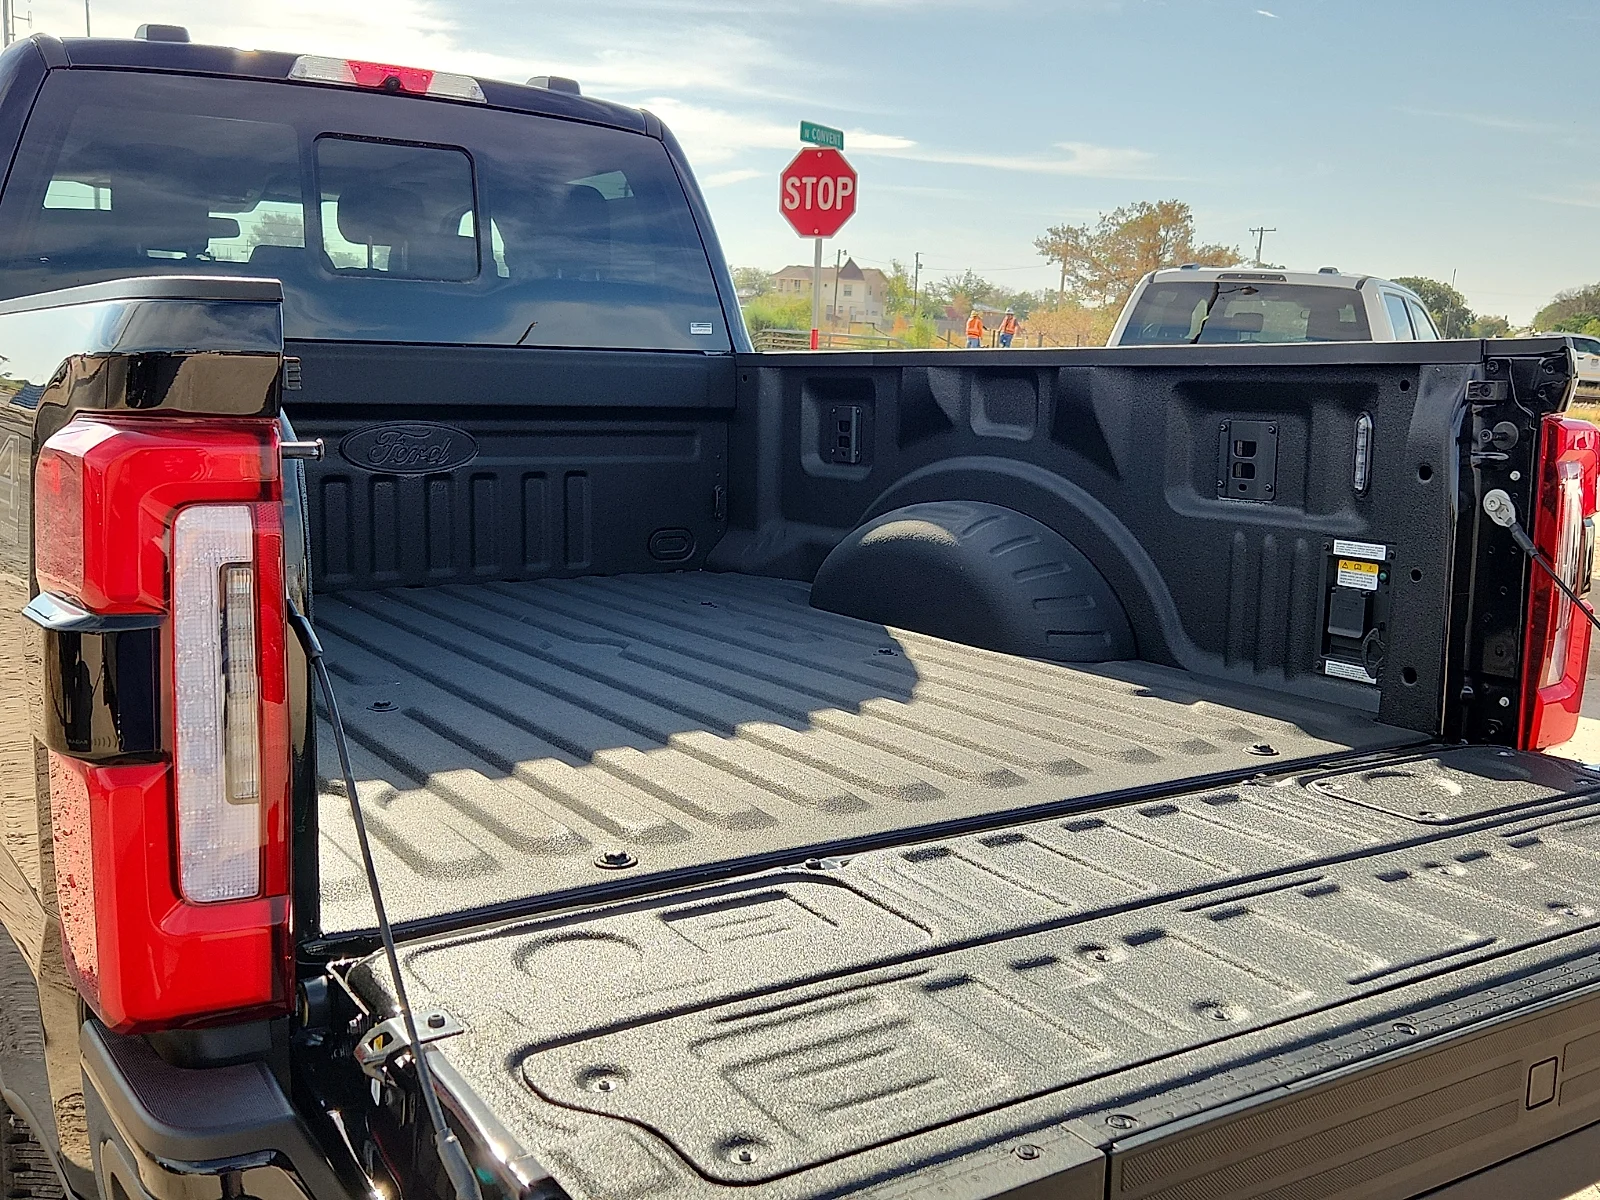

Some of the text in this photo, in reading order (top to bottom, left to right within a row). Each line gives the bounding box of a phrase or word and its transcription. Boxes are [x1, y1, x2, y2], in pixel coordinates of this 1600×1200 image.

[804, 128, 841, 145] N CONVENT
[784, 176, 854, 210] STOP
[368, 430, 451, 464] Ford
